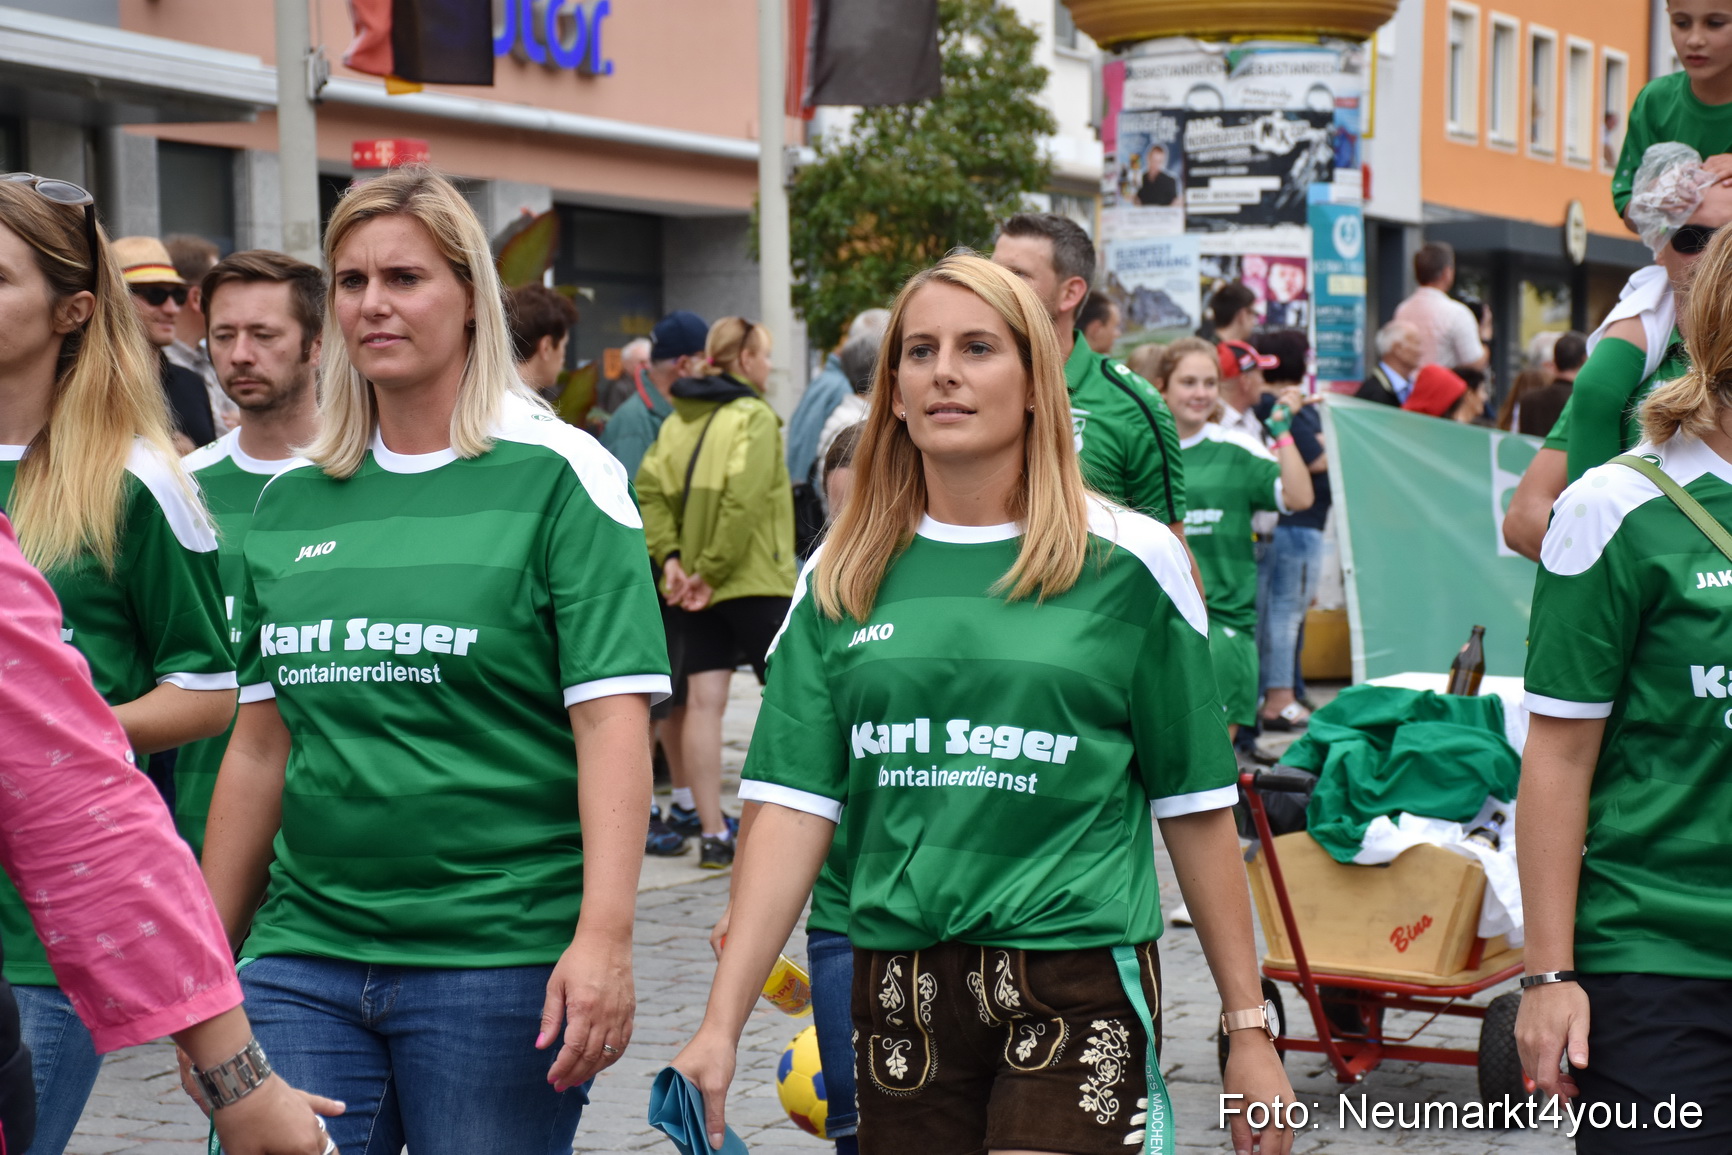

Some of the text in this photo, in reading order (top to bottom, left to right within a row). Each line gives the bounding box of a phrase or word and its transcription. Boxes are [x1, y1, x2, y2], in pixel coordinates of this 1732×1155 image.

[294, 540, 337, 563] JAKO
[1696, 569, 1732, 590] JAK
[260, 619, 334, 658] Karl
[344, 617, 479, 657] Seger
[847, 622, 895, 648] JAKO
[278, 661, 442, 687] Containerdienst
[851, 717, 1079, 765] Karl Seger
